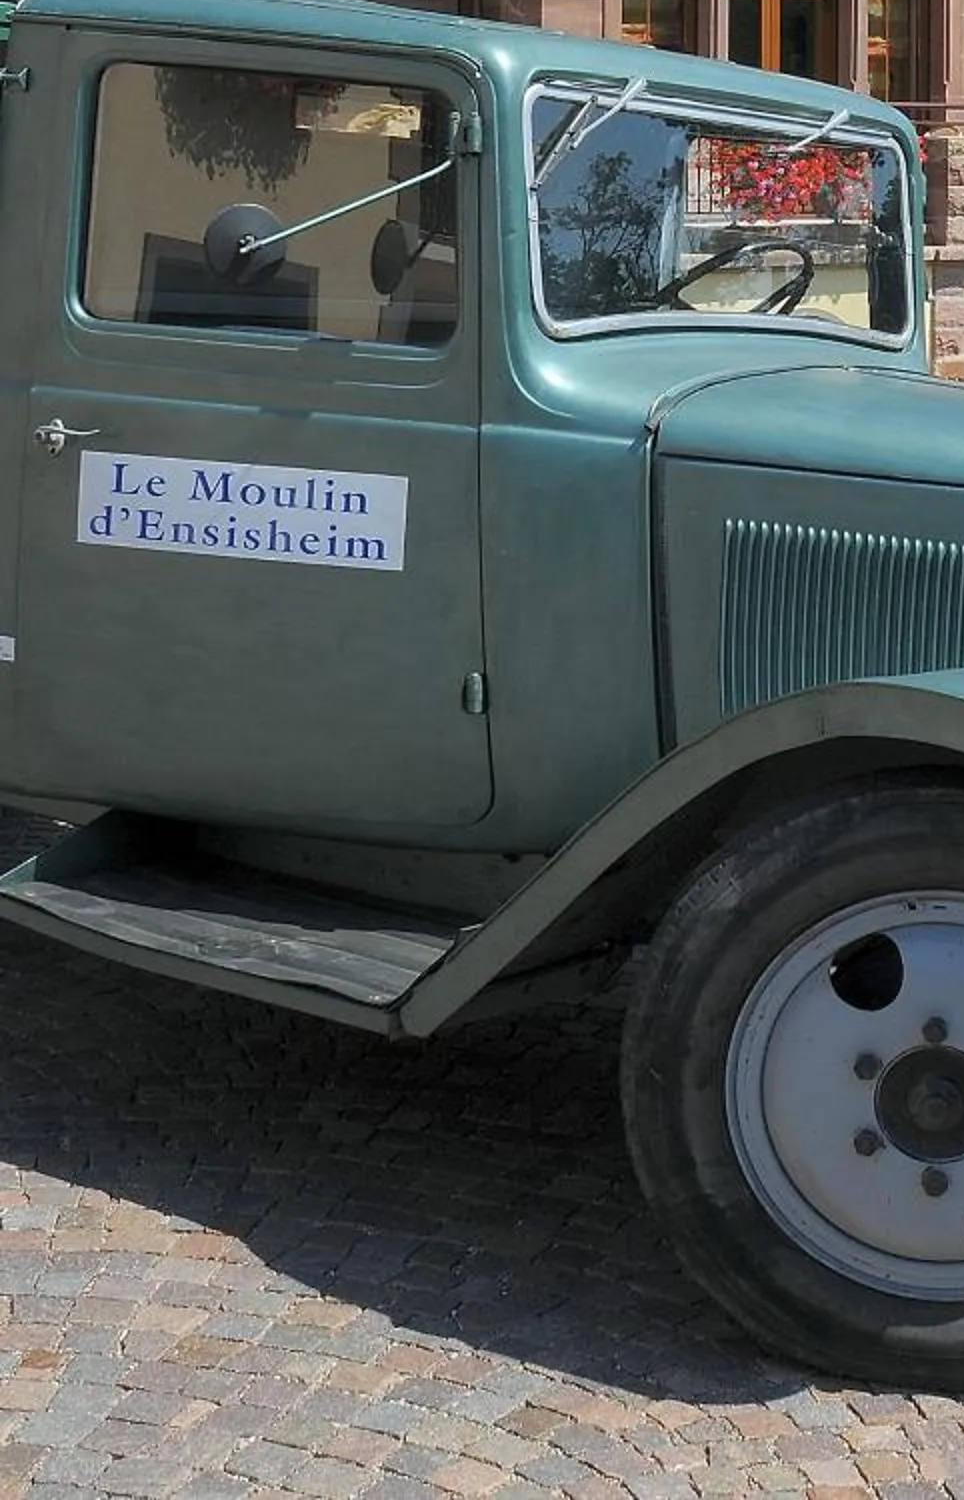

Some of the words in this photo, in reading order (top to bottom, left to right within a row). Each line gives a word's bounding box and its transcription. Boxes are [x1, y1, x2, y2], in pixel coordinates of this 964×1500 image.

[111, 462, 167, 498] Le
[189, 469, 369, 515] Moulin
[89, 505, 388, 561] d'Ensisheim
